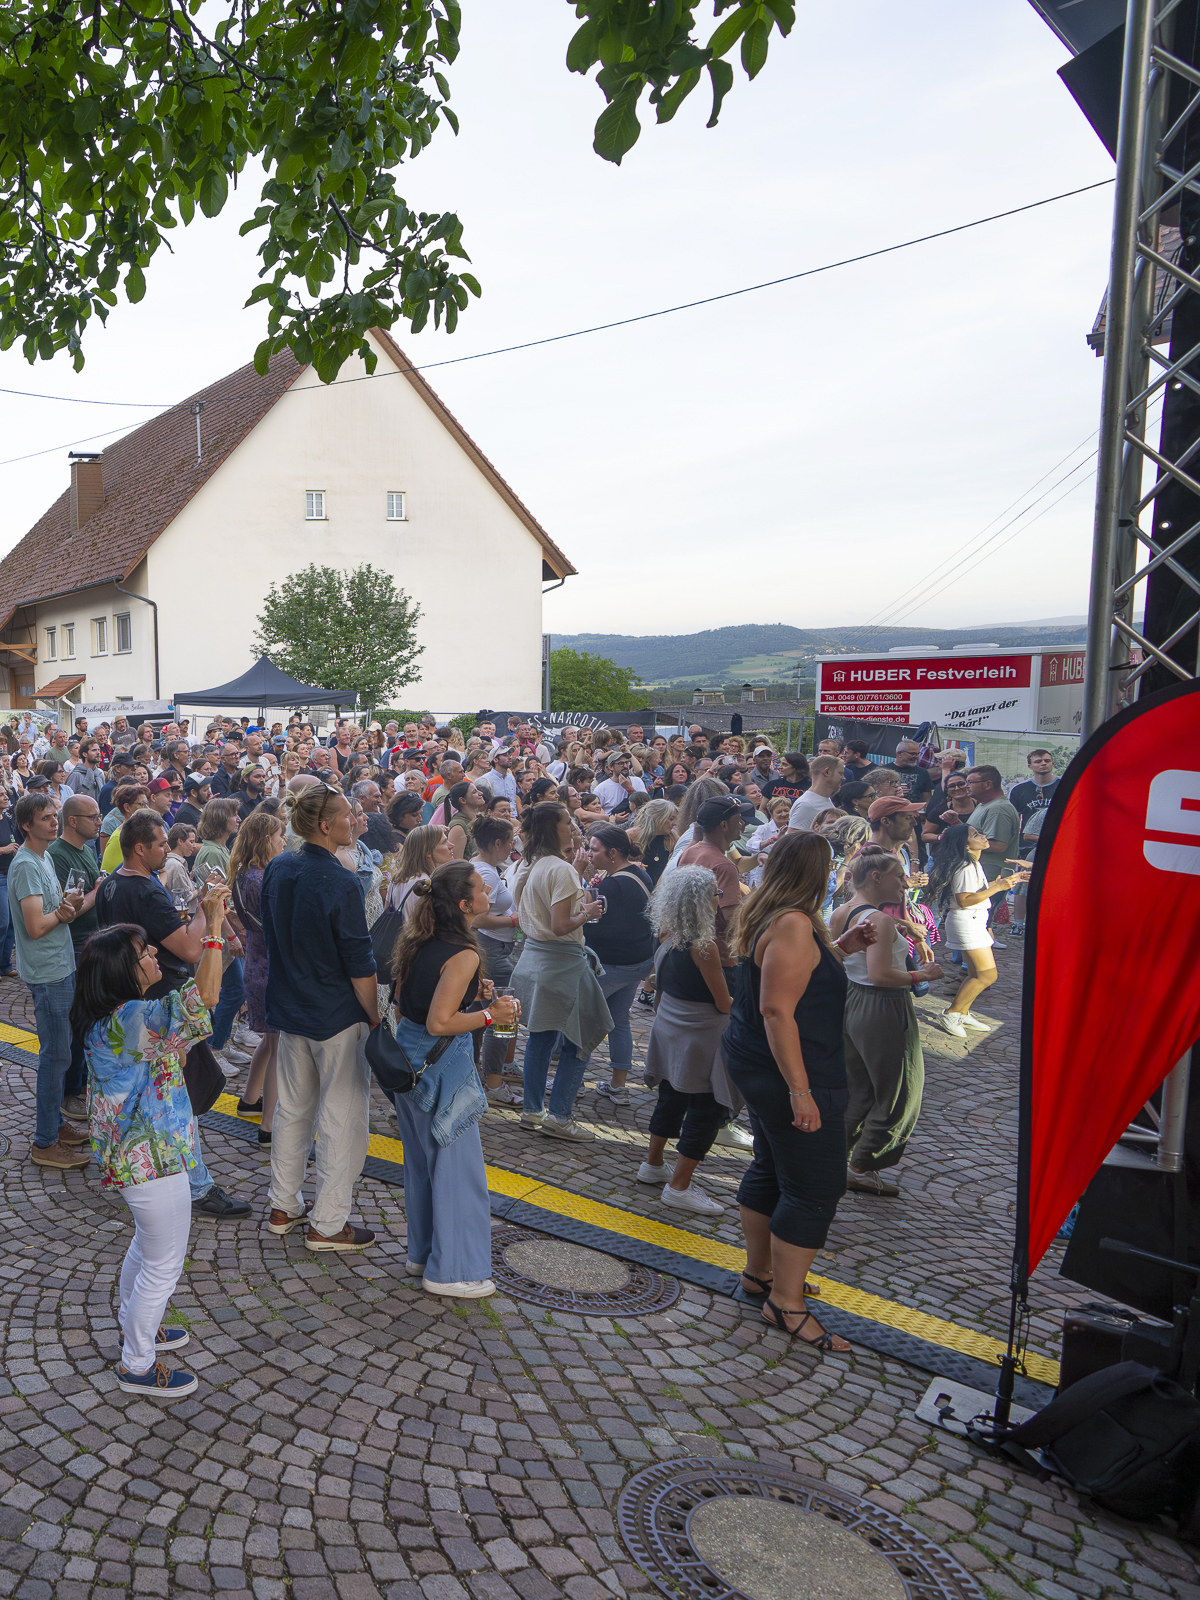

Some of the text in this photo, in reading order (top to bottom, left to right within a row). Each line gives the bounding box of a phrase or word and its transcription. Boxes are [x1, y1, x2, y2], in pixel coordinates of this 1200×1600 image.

[850, 665, 1017, 682] HUBER Festverleih
[825, 693, 837, 701] Tel.
[838, 693, 855, 701] 0049
[838, 704, 855, 712] 0049
[967, 702, 997, 716] tanzt
[998, 698, 1019, 710] der
